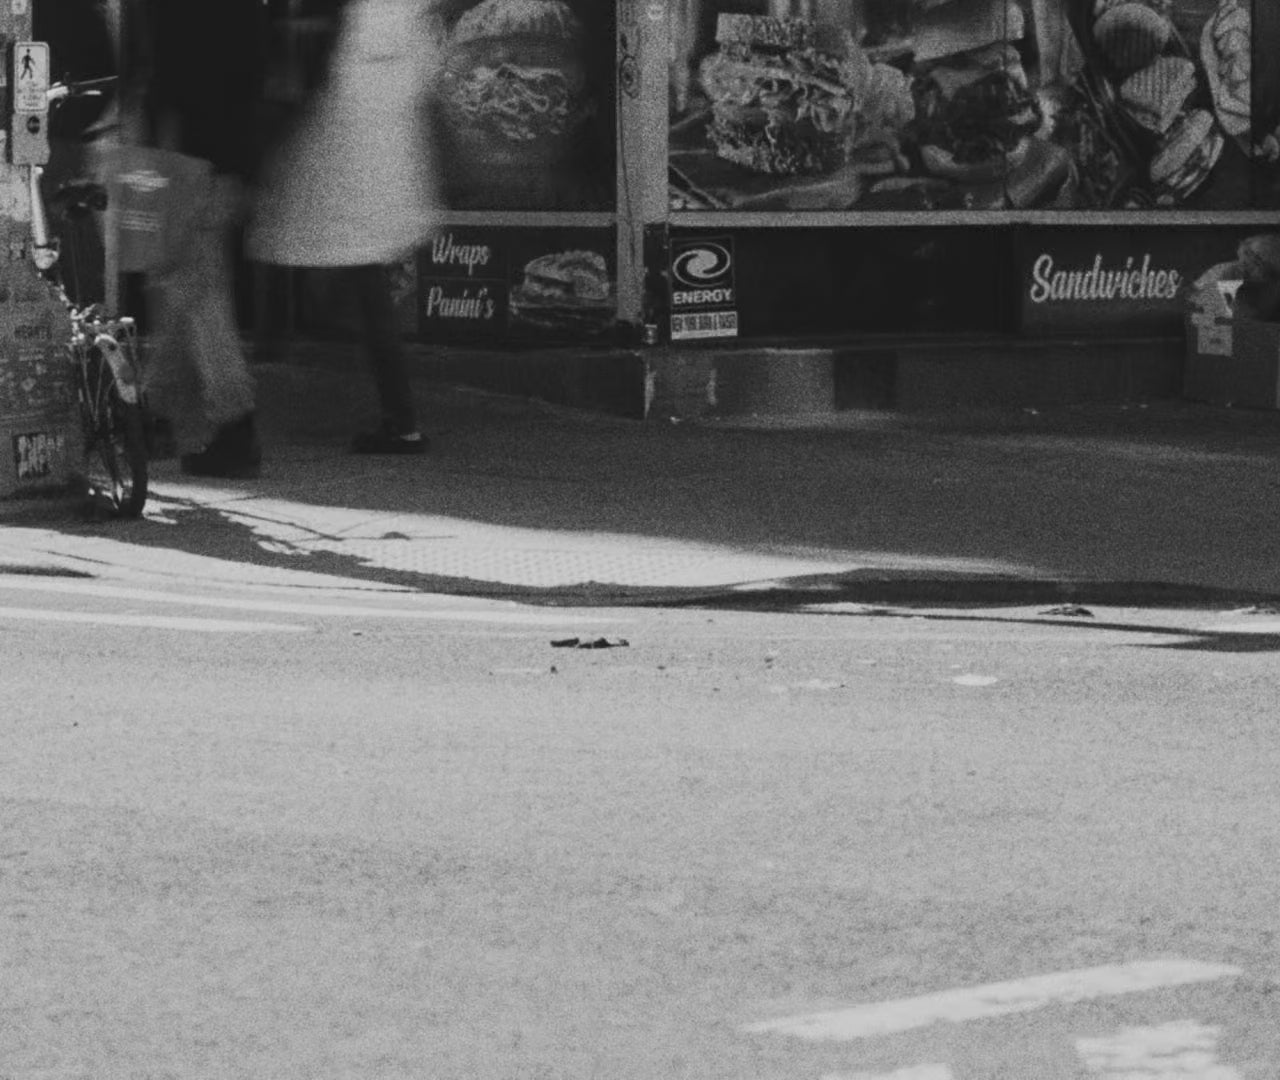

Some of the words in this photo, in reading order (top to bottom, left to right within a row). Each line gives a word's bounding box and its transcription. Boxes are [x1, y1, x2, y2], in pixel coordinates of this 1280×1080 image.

[431, 232, 492, 276] Wraps
[672, 287, 733, 305] ENERGY
[1029, 253, 1182, 303] Sandwiches
[426, 286, 496, 320] Panini's
